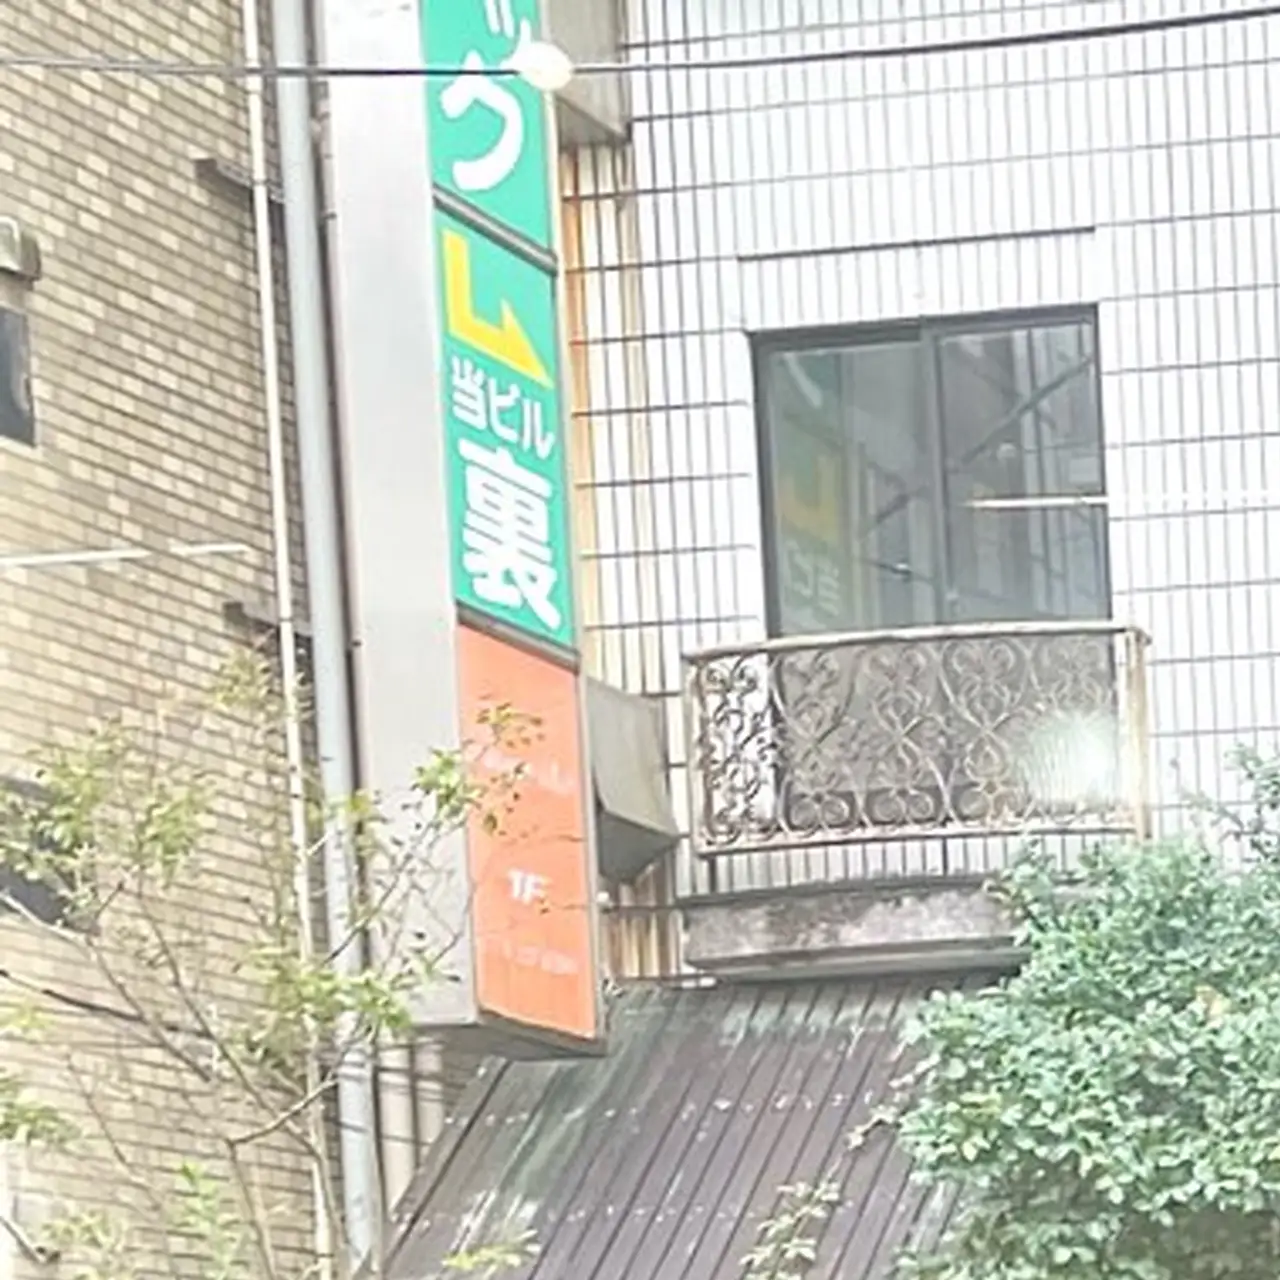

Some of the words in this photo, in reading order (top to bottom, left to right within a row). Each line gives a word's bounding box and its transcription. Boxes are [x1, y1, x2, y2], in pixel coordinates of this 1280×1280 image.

[451, 354, 555, 460] 当ビル
[457, 437, 561, 630] 裏
